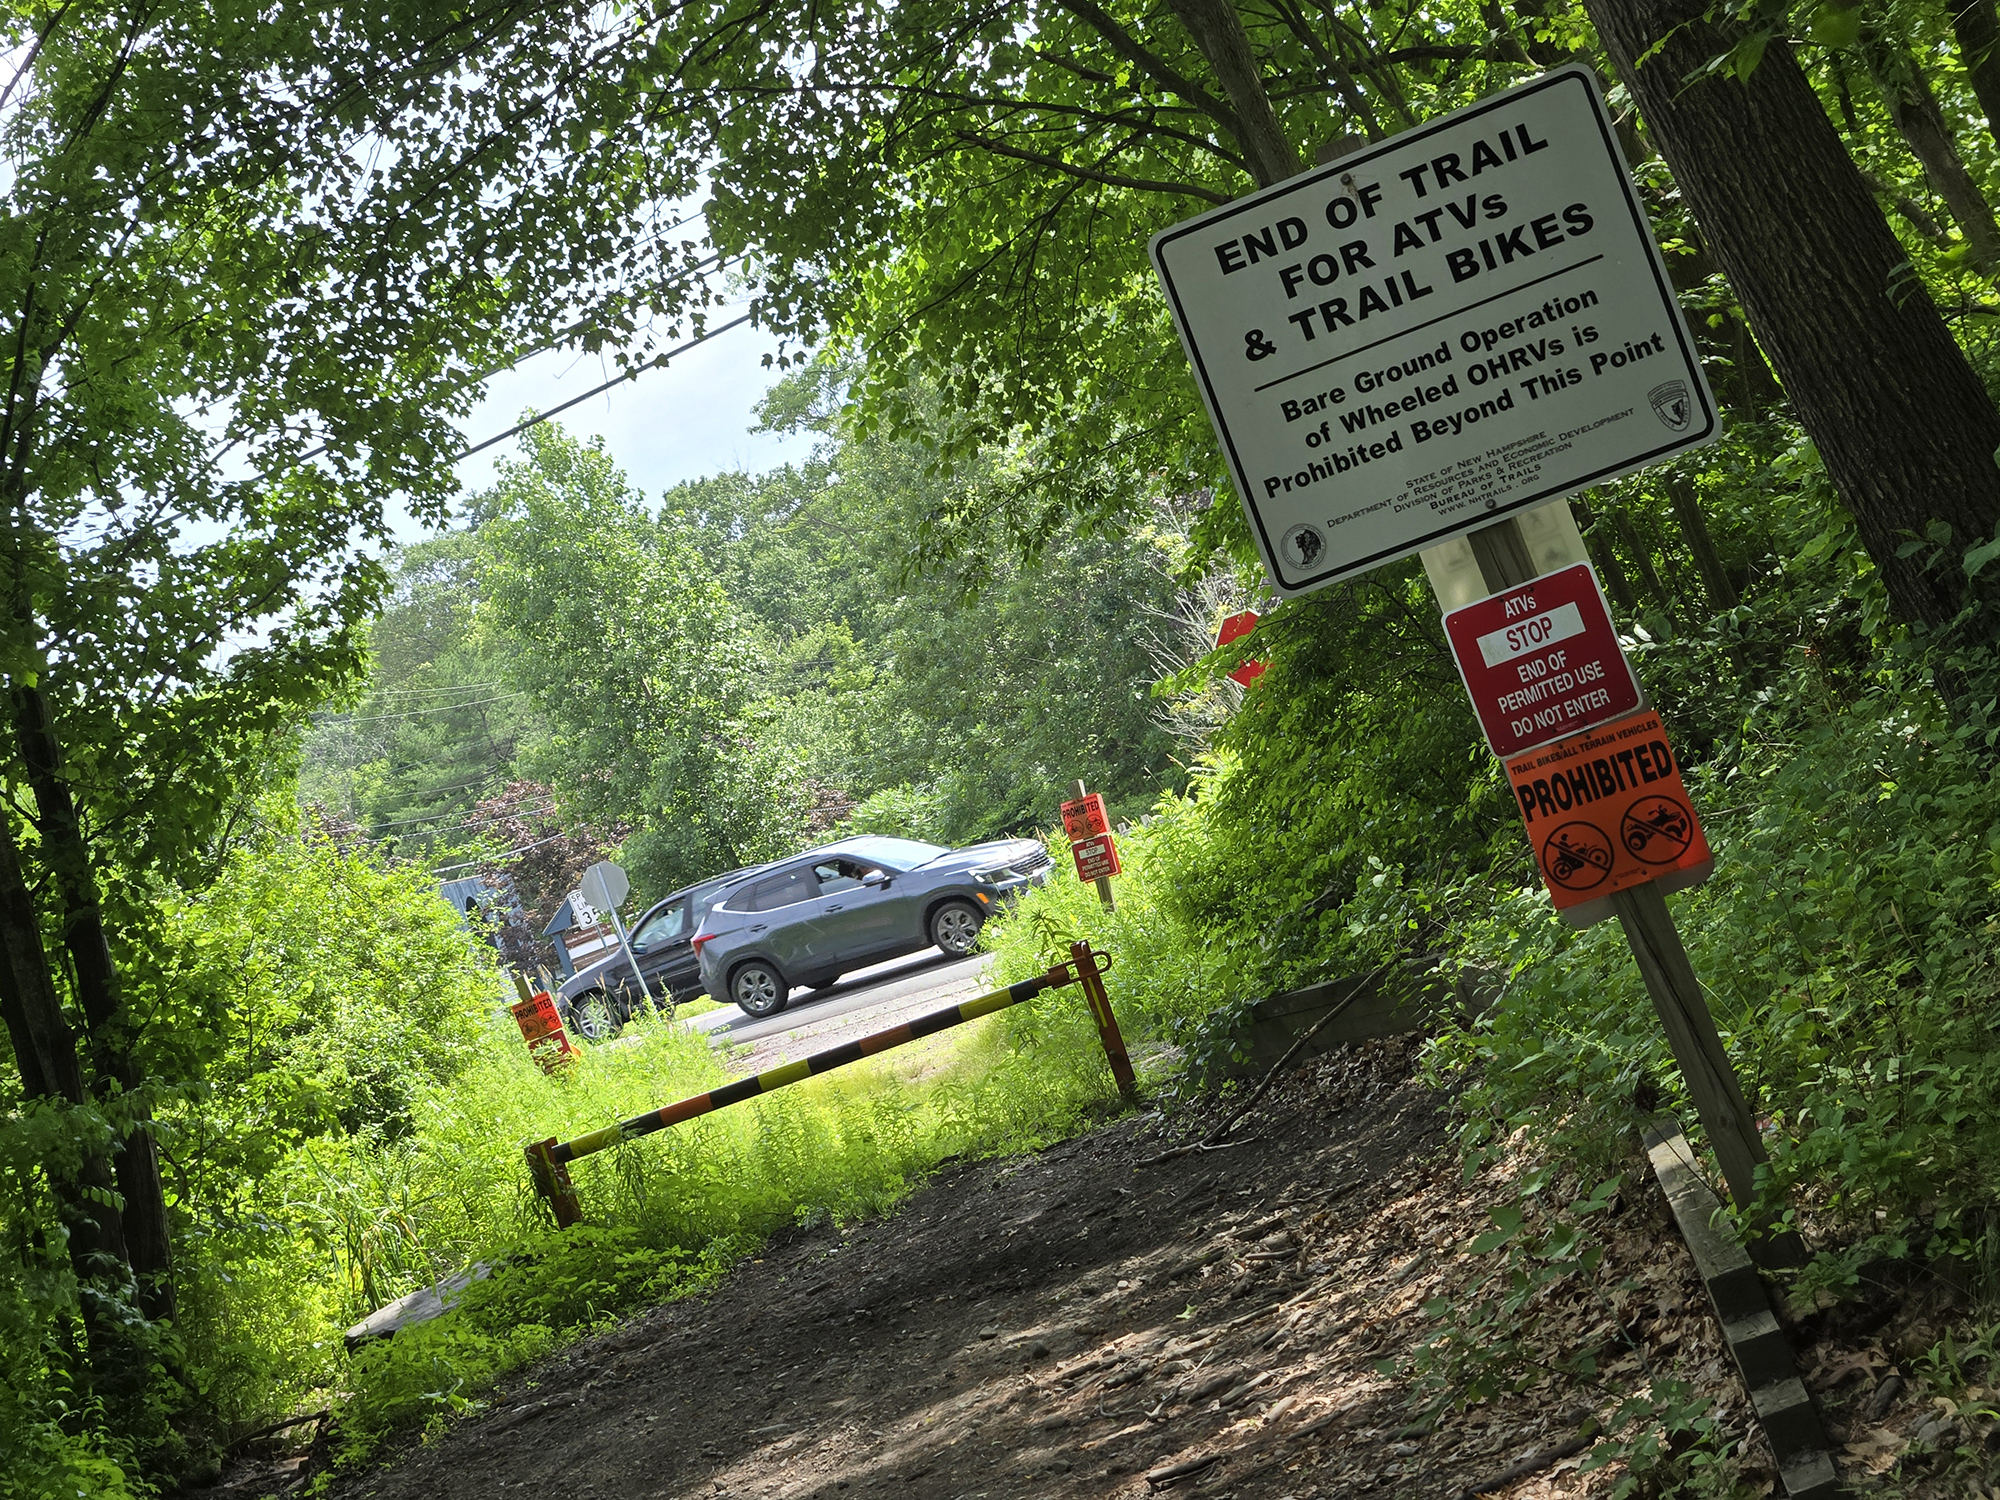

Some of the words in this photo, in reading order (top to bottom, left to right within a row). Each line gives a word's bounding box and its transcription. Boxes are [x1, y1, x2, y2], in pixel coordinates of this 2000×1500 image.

[1213, 216, 1308, 276] END
[1325, 181, 1383, 230] OF
[1398, 123, 1549, 199] TRAIL
[1278, 239, 1377, 300] FOR
[1393, 193, 1508, 258] ATVs
[1244, 329, 1278, 362] &
[1287, 269, 1434, 342] TRAIL
[1445, 202, 1594, 284] BIKES
[1280, 387, 1346, 423] Bare
[1354, 340, 1453, 394] Ground
[1460, 290, 1599, 353] Operation
[1305, 421, 1332, 449] of
[1338, 373, 1460, 434] Wheeled
[1467, 337, 1565, 386] OHRVs
[1571, 325, 1599, 347] is
[1263, 429, 1404, 499] Prohibited
[1409, 387, 1515, 444] Beyond
[1519, 367, 1583, 401] This
[1589, 331, 1666, 376] Point
[1496, 466, 1505, 476] &
[1504, 594, 1537, 619] ATVs
[1506, 616, 1553, 652] STOP
[1497, 672, 1574, 714] PERMITTED
[1574, 660, 1605, 685] USE
[1516, 658, 1547, 683] END
[1548, 649, 1567, 671] OF
[1510, 716, 1533, 738] DO
[1533, 704, 1563, 730] NOT
[1563, 688, 1611, 718] ENTER
[1510, 761, 1536, 776] TRAIL
[1536, 746, 1579, 767] BIKES/ALL
[1578, 733, 1617, 753] TERRAIN
[1616, 719, 1659, 740] VEHICLES
[1516, 740, 1673, 823] PROHIBITED
[1062, 800, 1099, 819] PROHIBITED
[1085, 846, 1099, 856] STOP
[514, 998, 553, 1021] PROHIBITED
